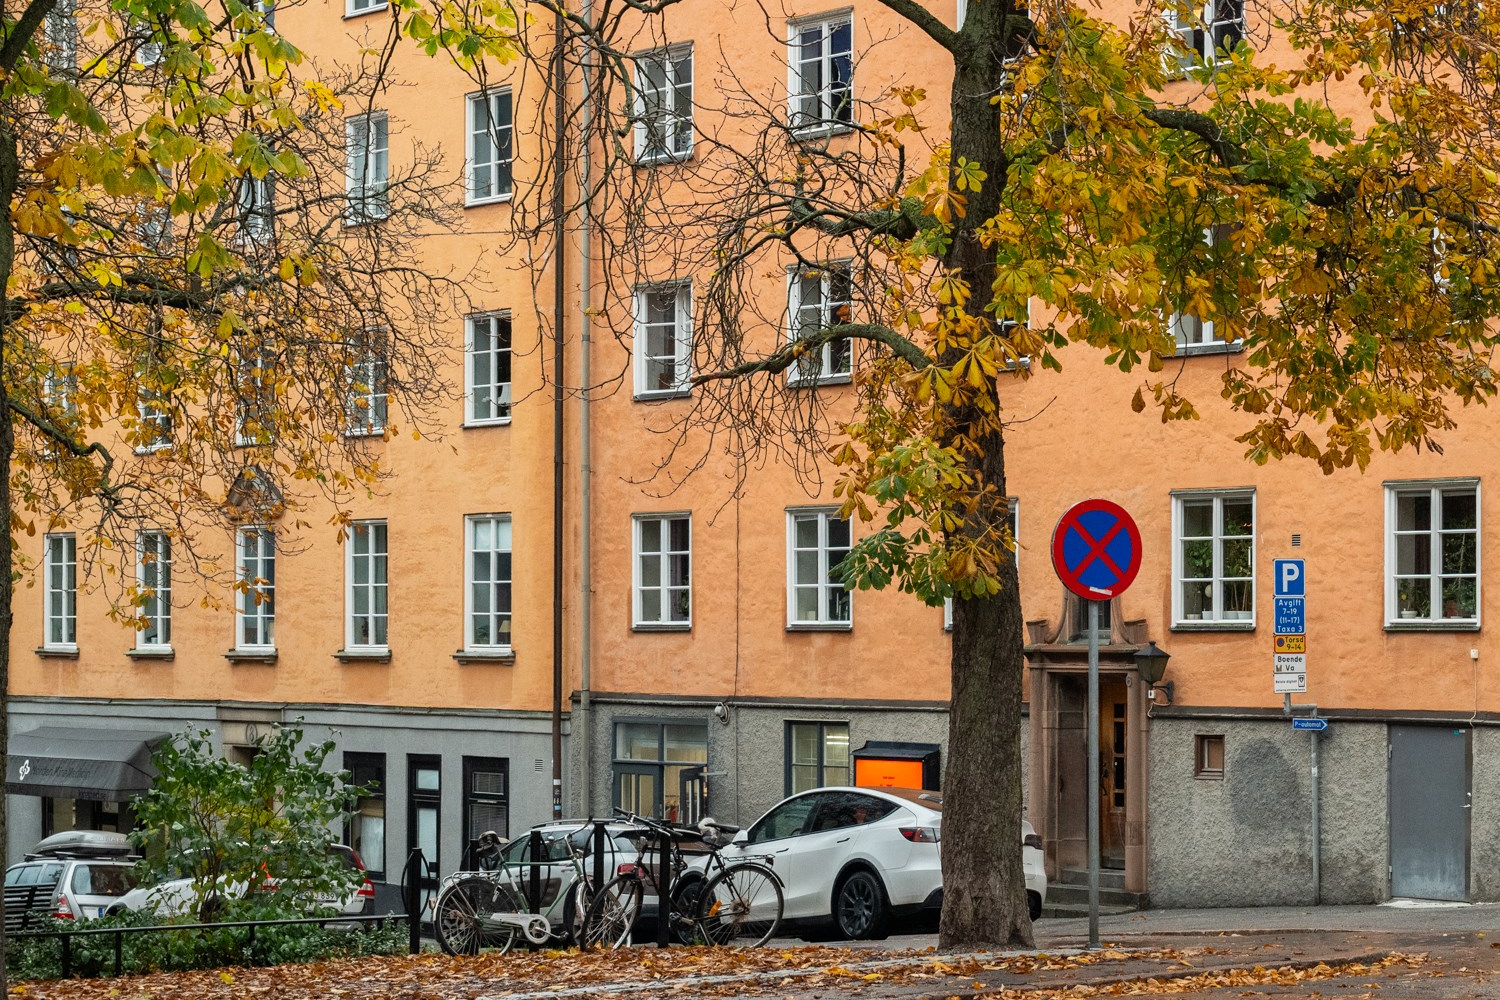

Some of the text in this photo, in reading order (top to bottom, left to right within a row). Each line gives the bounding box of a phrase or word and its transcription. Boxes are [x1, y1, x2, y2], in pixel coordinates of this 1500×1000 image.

[1282, 563, 1299, 592] P
[1278, 599, 1301, 608] Avgift
[1282, 607, 1297, 615] 7-19
[1279, 616, 1300, 625] (11-17)
[1277, 625, 1303, 633] Taxa 3
[1286, 643, 1302, 651] 9-14
[1277, 655, 1303, 663] Boende
